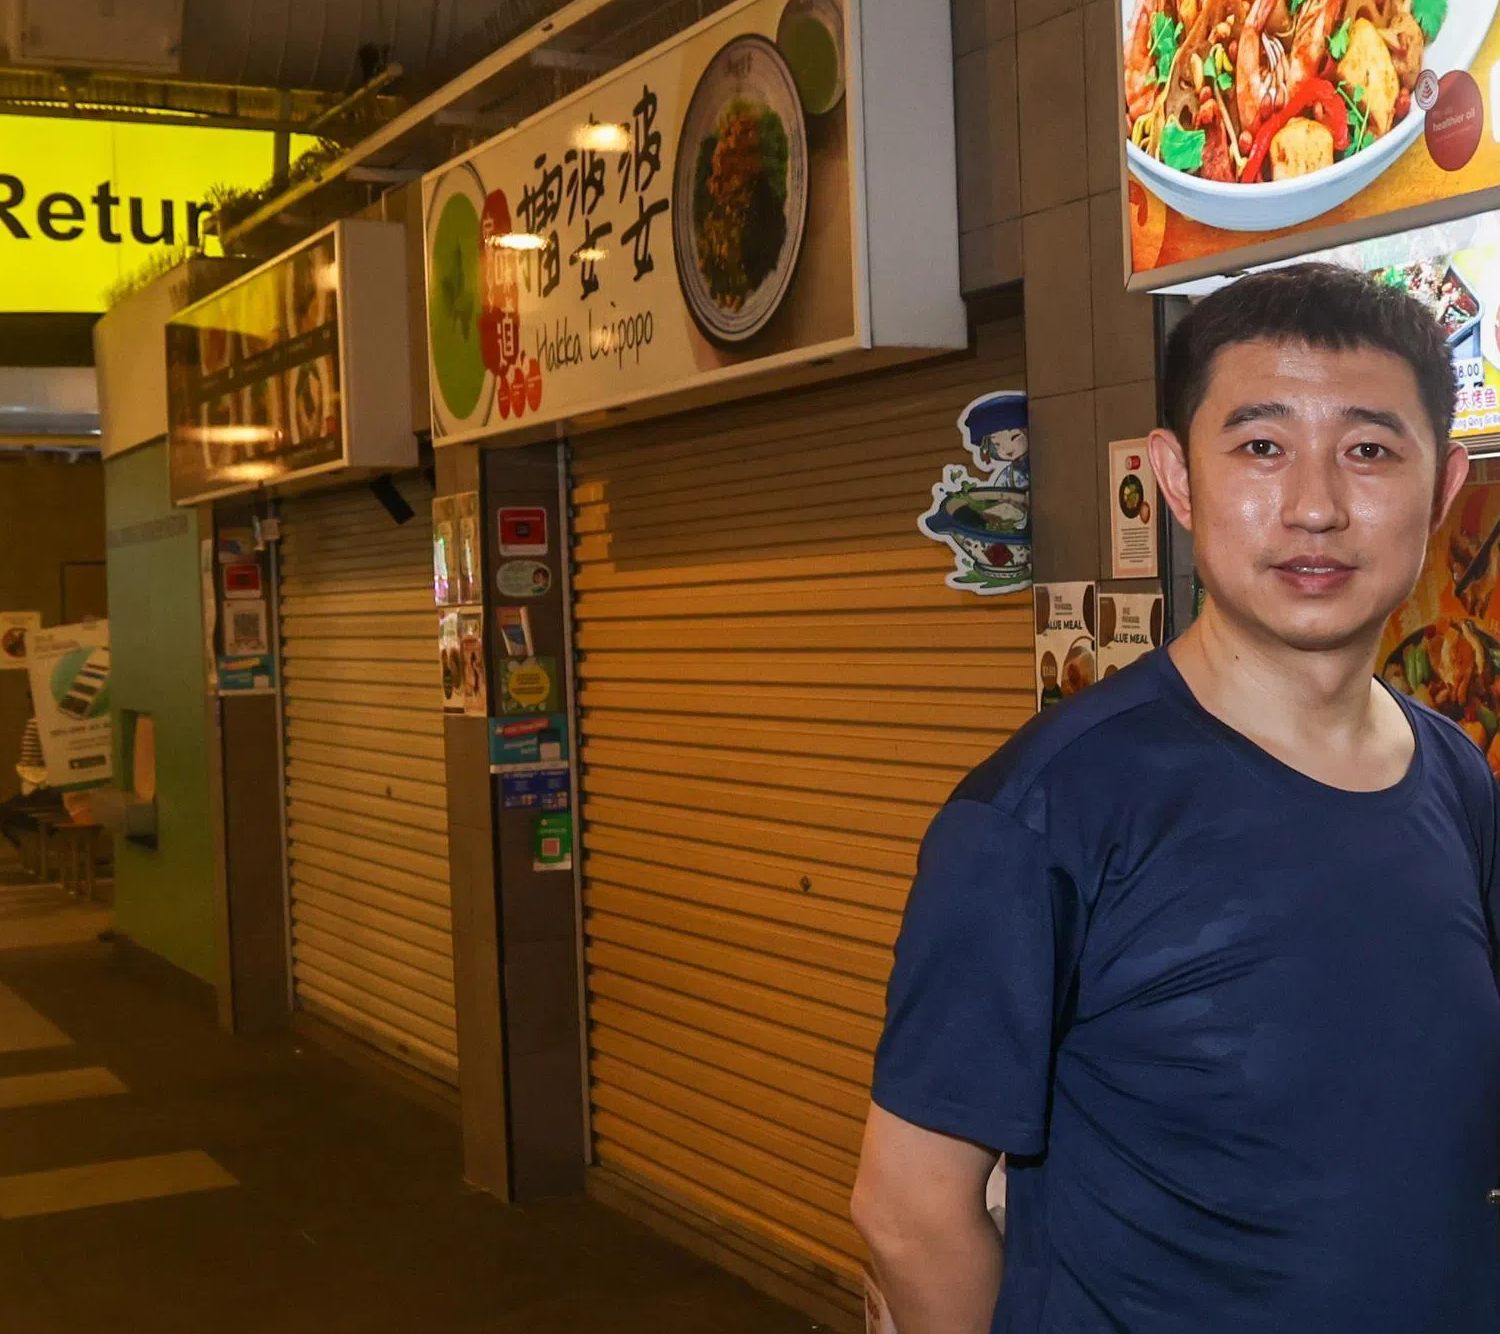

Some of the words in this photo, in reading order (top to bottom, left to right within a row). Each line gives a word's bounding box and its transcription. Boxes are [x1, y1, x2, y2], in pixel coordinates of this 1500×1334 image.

[536, 315, 583, 372] Hakka
[1063, 618, 1083, 631] MEAL
[1129, 633, 1149, 645] MEAL
